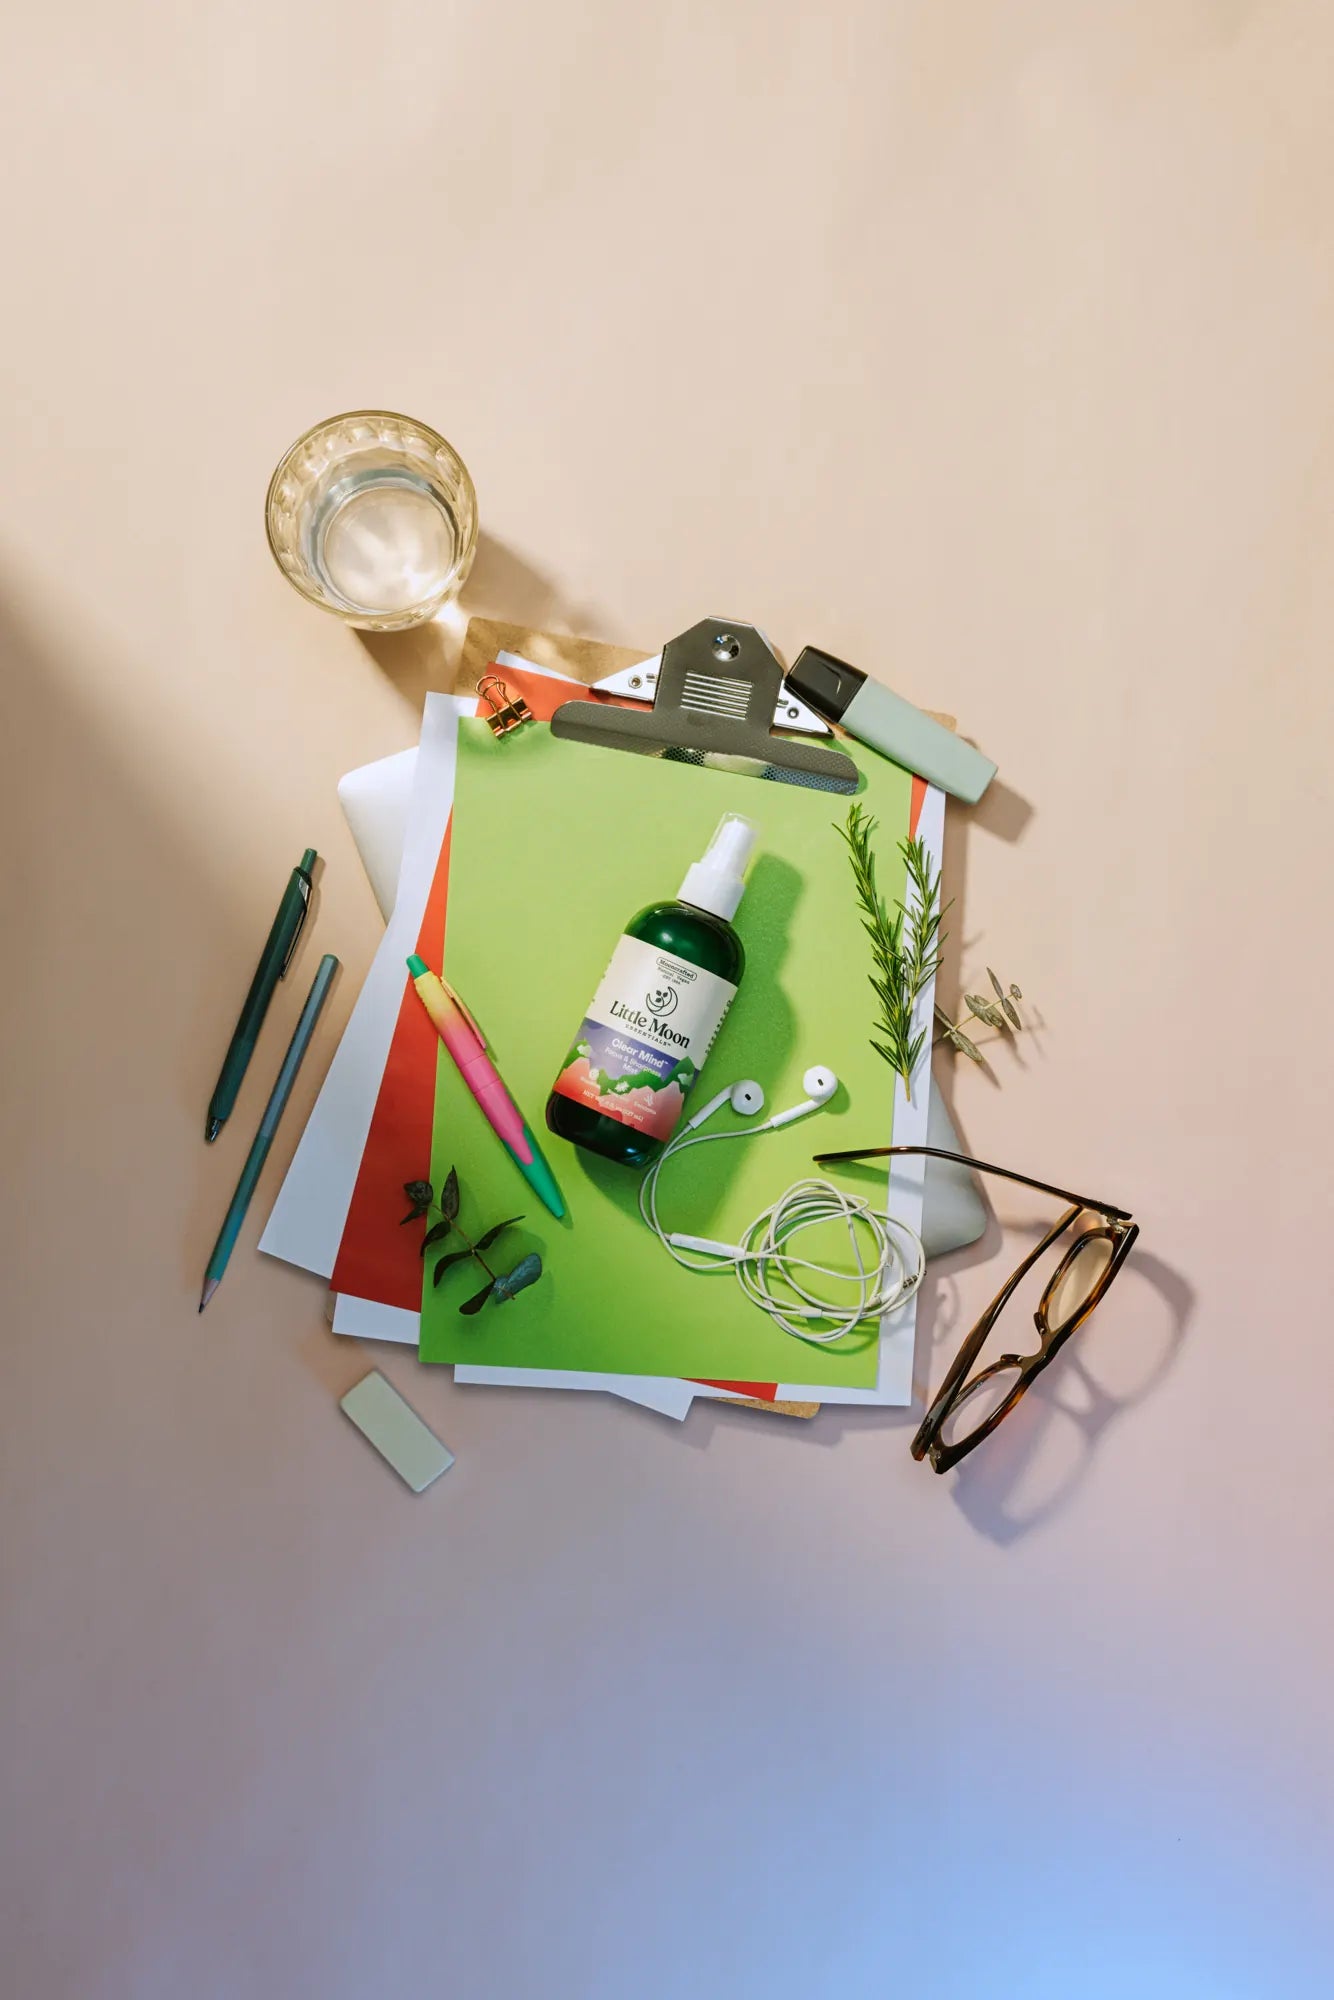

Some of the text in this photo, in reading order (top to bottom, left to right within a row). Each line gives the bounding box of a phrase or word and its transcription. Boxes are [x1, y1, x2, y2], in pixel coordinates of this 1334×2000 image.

[660, 959, 694, 979] Mooncrafted
[609, 1000, 647, 1028] Little
[648, 1018, 691, 1049] Moon
[605, 1046, 623, 1060] Focus
[612, 1038, 638, 1056] Clear
[623, 1063, 638, 1075] Mist
